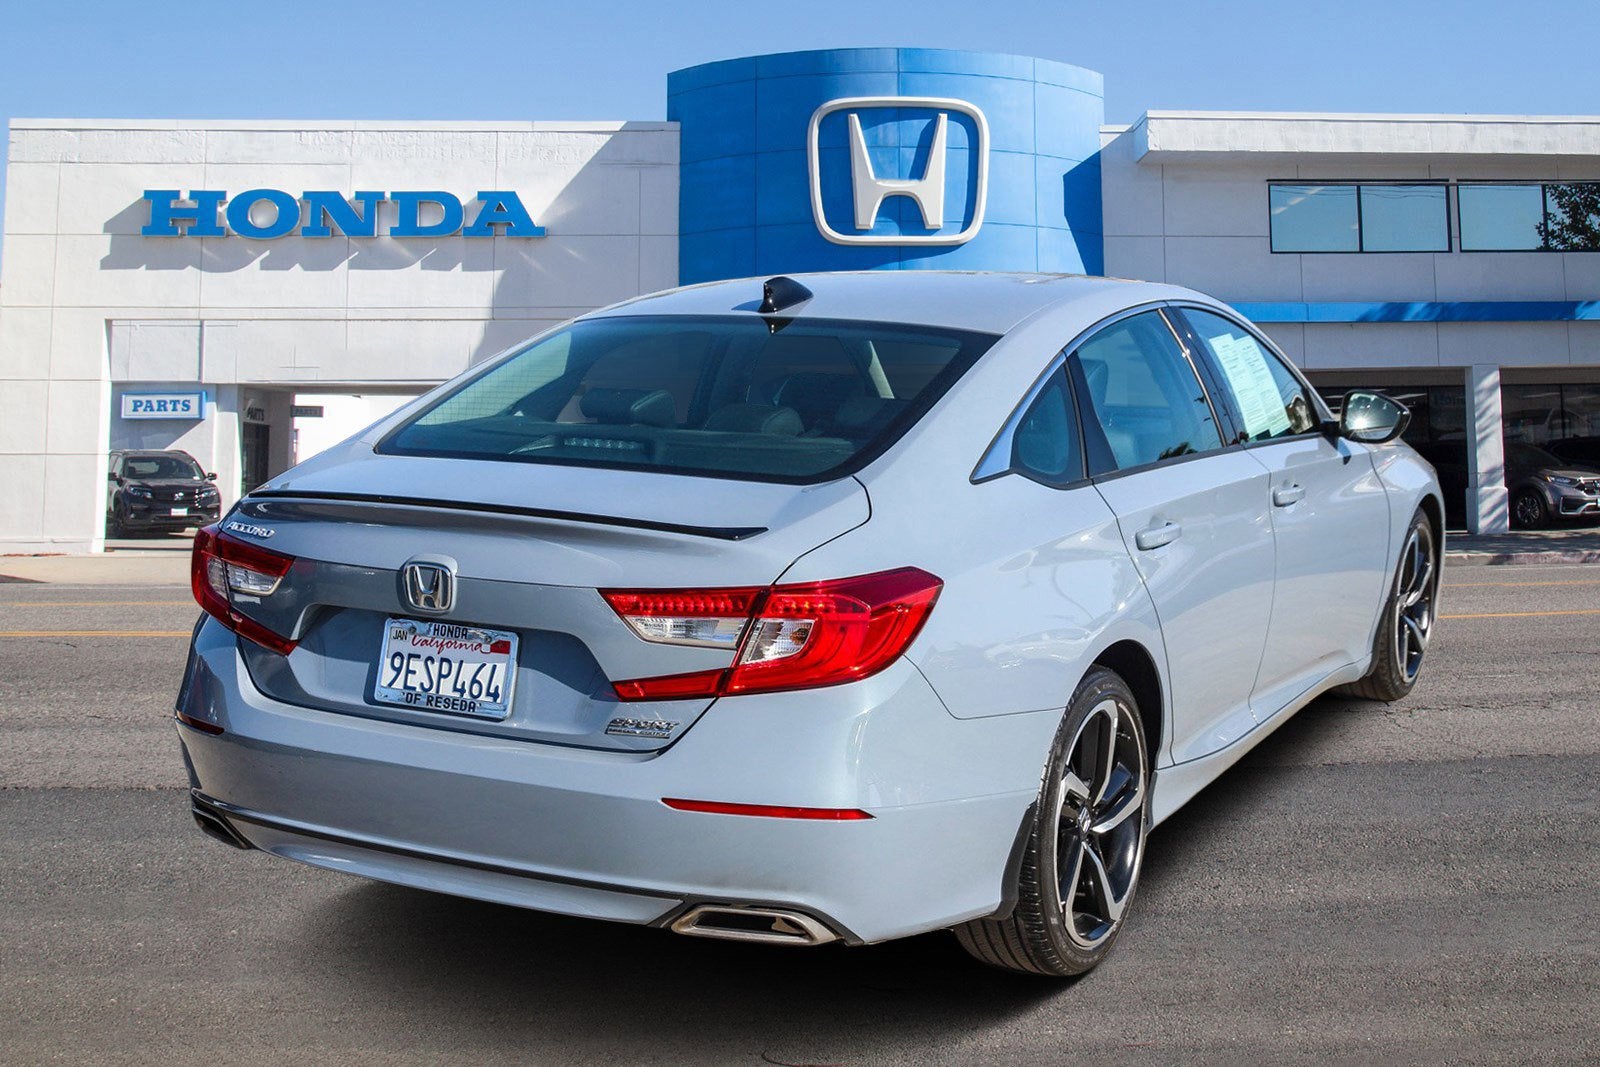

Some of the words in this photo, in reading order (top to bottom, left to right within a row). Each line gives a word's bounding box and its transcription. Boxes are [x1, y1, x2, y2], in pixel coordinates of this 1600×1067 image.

[141, 188, 546, 240] HONDA
[132, 399, 191, 413] PARTS
[246, 407, 264, 421] PARTS
[392, 628, 408, 641] JAN
[433, 623, 468, 640] HONDA
[411, 635, 491, 655] California
[389, 651, 501, 702] 9ESP464
[405, 693, 422, 706] OF
[426, 695, 477, 713] RESEDA
